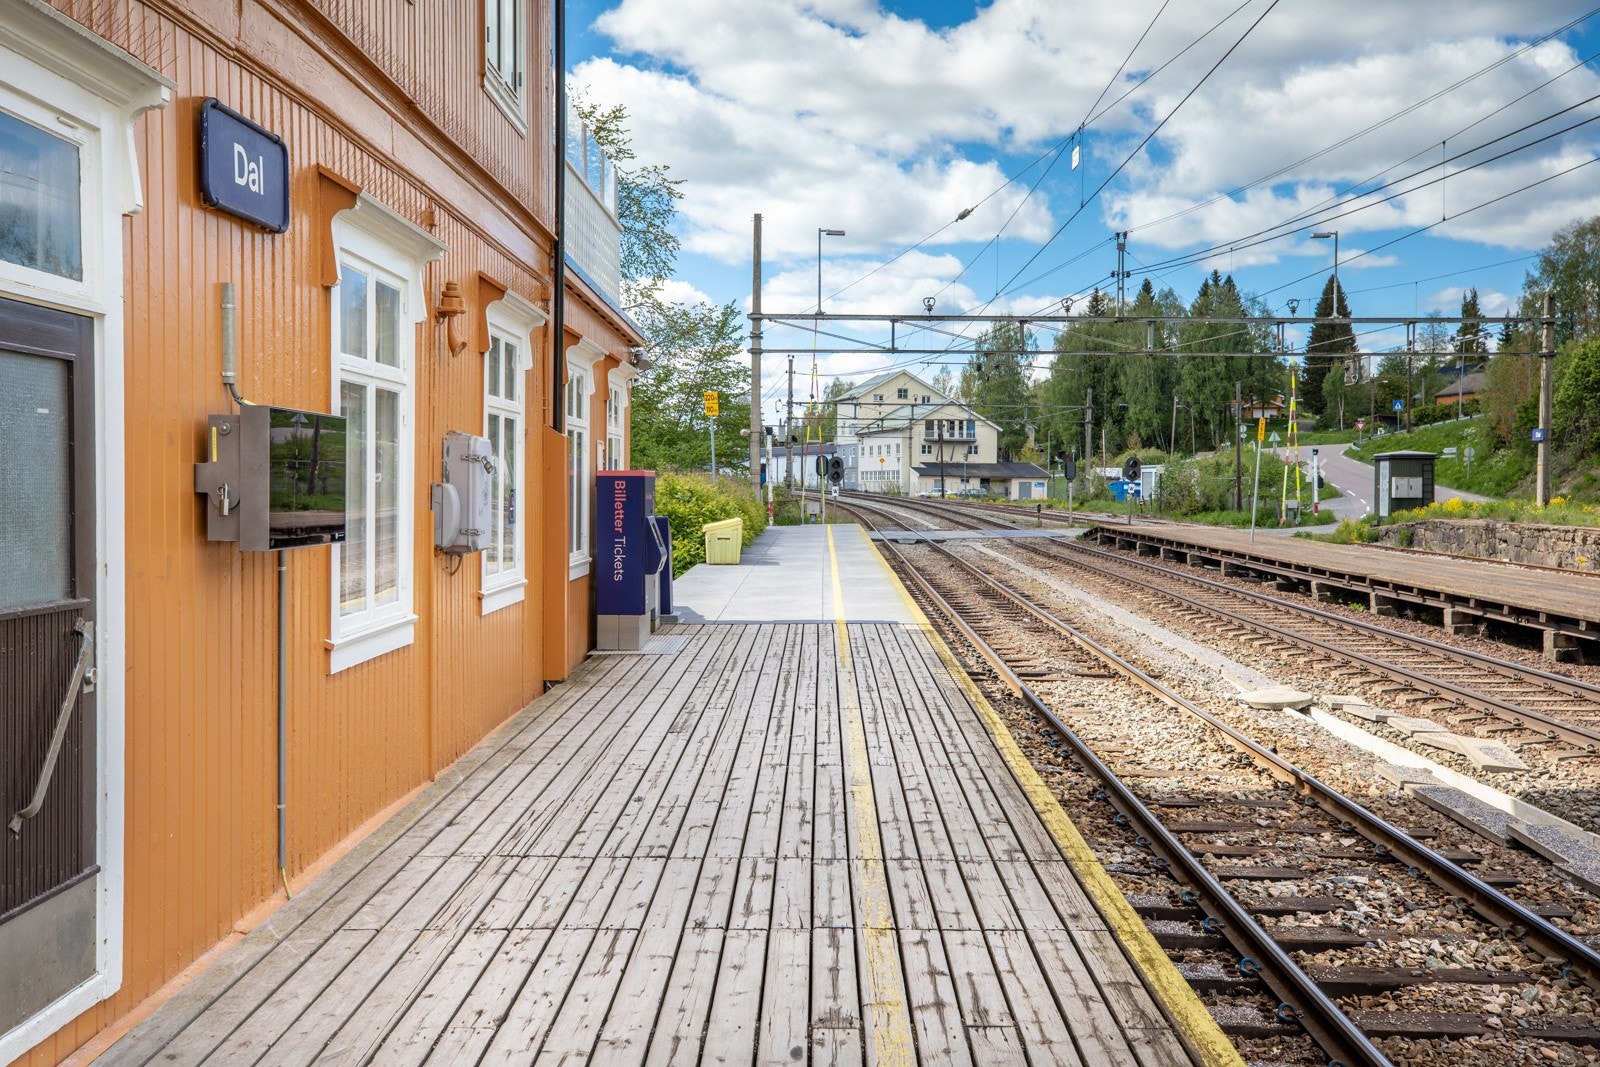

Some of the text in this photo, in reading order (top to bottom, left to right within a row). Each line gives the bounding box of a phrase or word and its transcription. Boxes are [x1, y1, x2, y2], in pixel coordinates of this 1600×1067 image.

[233, 142, 264, 195] Dal
[614, 480, 626, 581] Billetter Tickets
